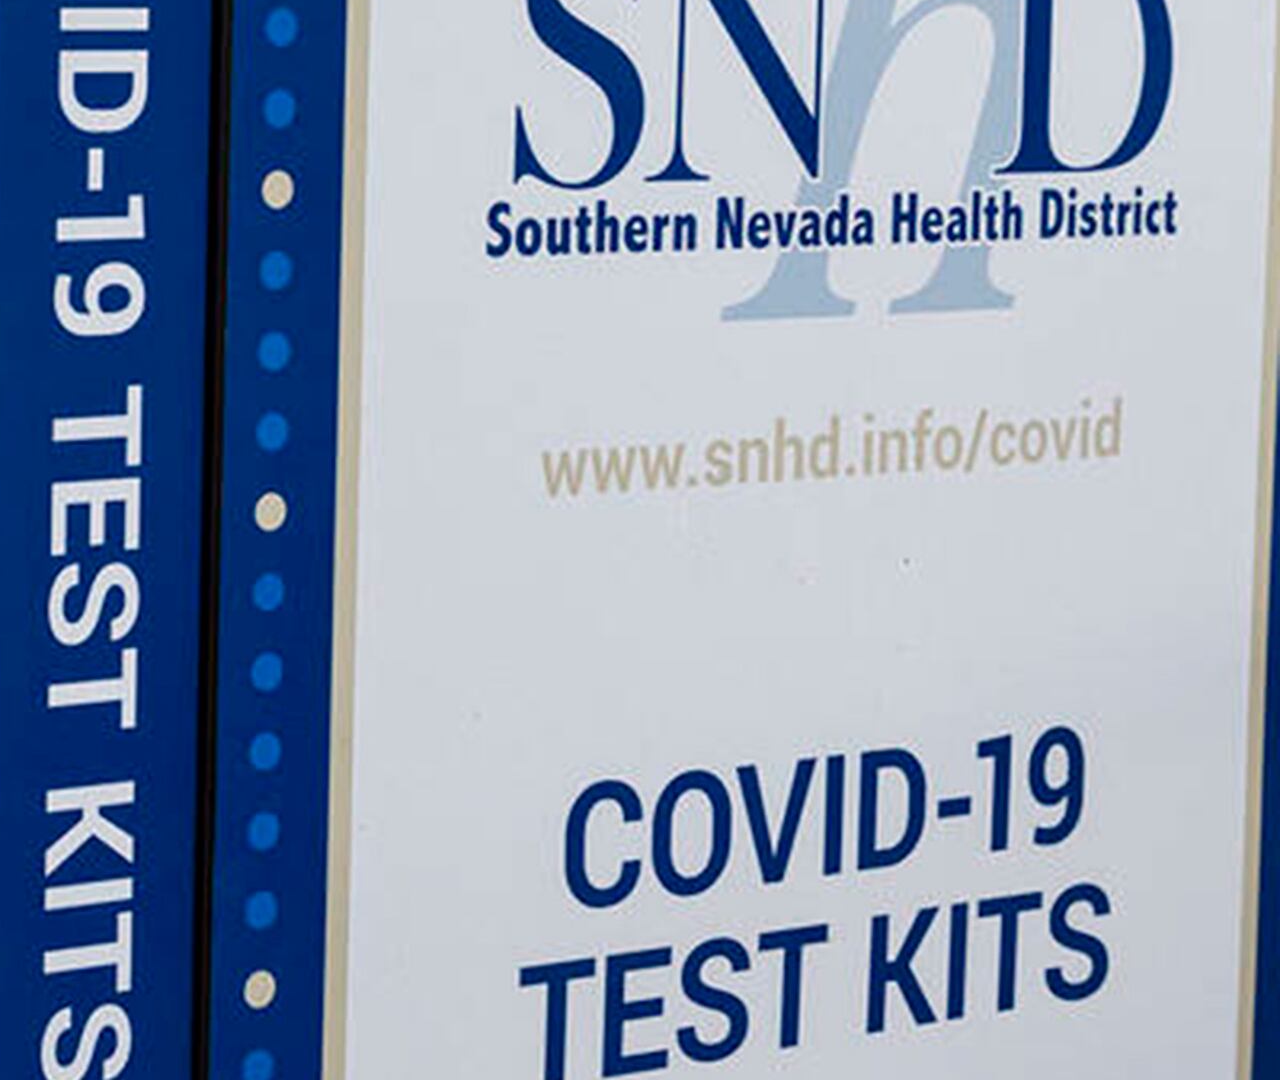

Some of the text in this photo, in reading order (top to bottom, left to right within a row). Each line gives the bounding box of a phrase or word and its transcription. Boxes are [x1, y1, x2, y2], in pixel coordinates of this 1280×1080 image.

[485, 187, 1178, 258] Southern Nevada Health District
[542, 398, 1122, 497] www.snhd.info/covid
[47, 385, 142, 729] TEST
[564, 725, 1085, 909] COVID-19
[41, 781, 135, 1080] KITS
[519, 882, 1111, 1080] TEST KITS
